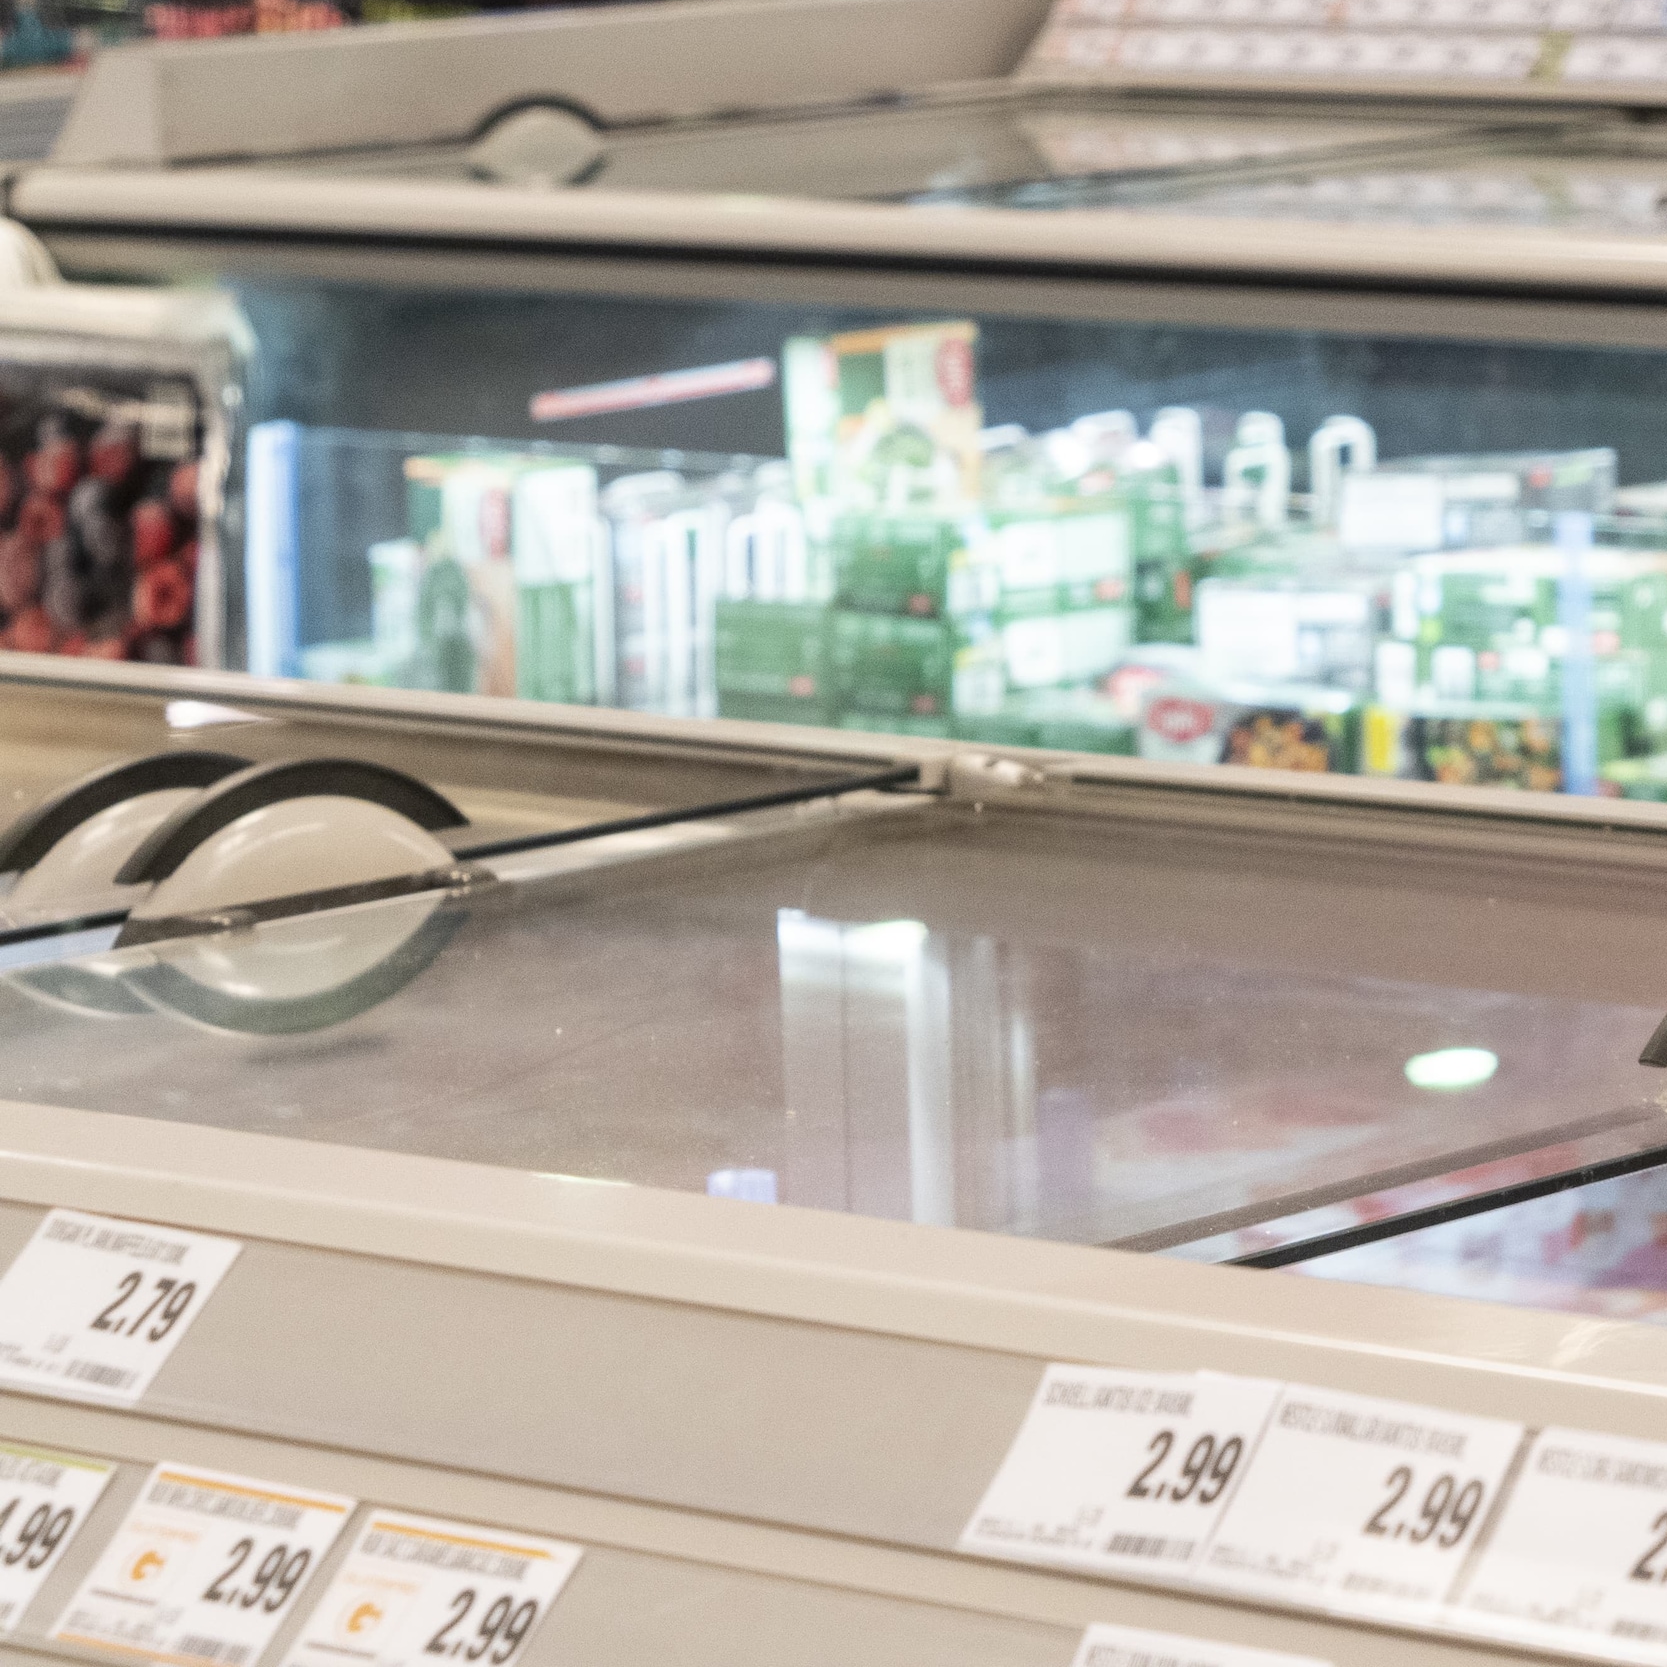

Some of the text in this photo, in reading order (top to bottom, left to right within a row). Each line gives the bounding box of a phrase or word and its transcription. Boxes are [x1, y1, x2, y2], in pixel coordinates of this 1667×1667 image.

[90, 1270, 198, 1344] 2.79
[1126, 1429, 1245, 1506] 2.99
[0, 1499, 76, 1571] 99
[1363, 1465, 1486, 1550] 2.99
[202, 1537, 313, 1615] 2.99
[424, 1588, 540, 1666] 2.99
